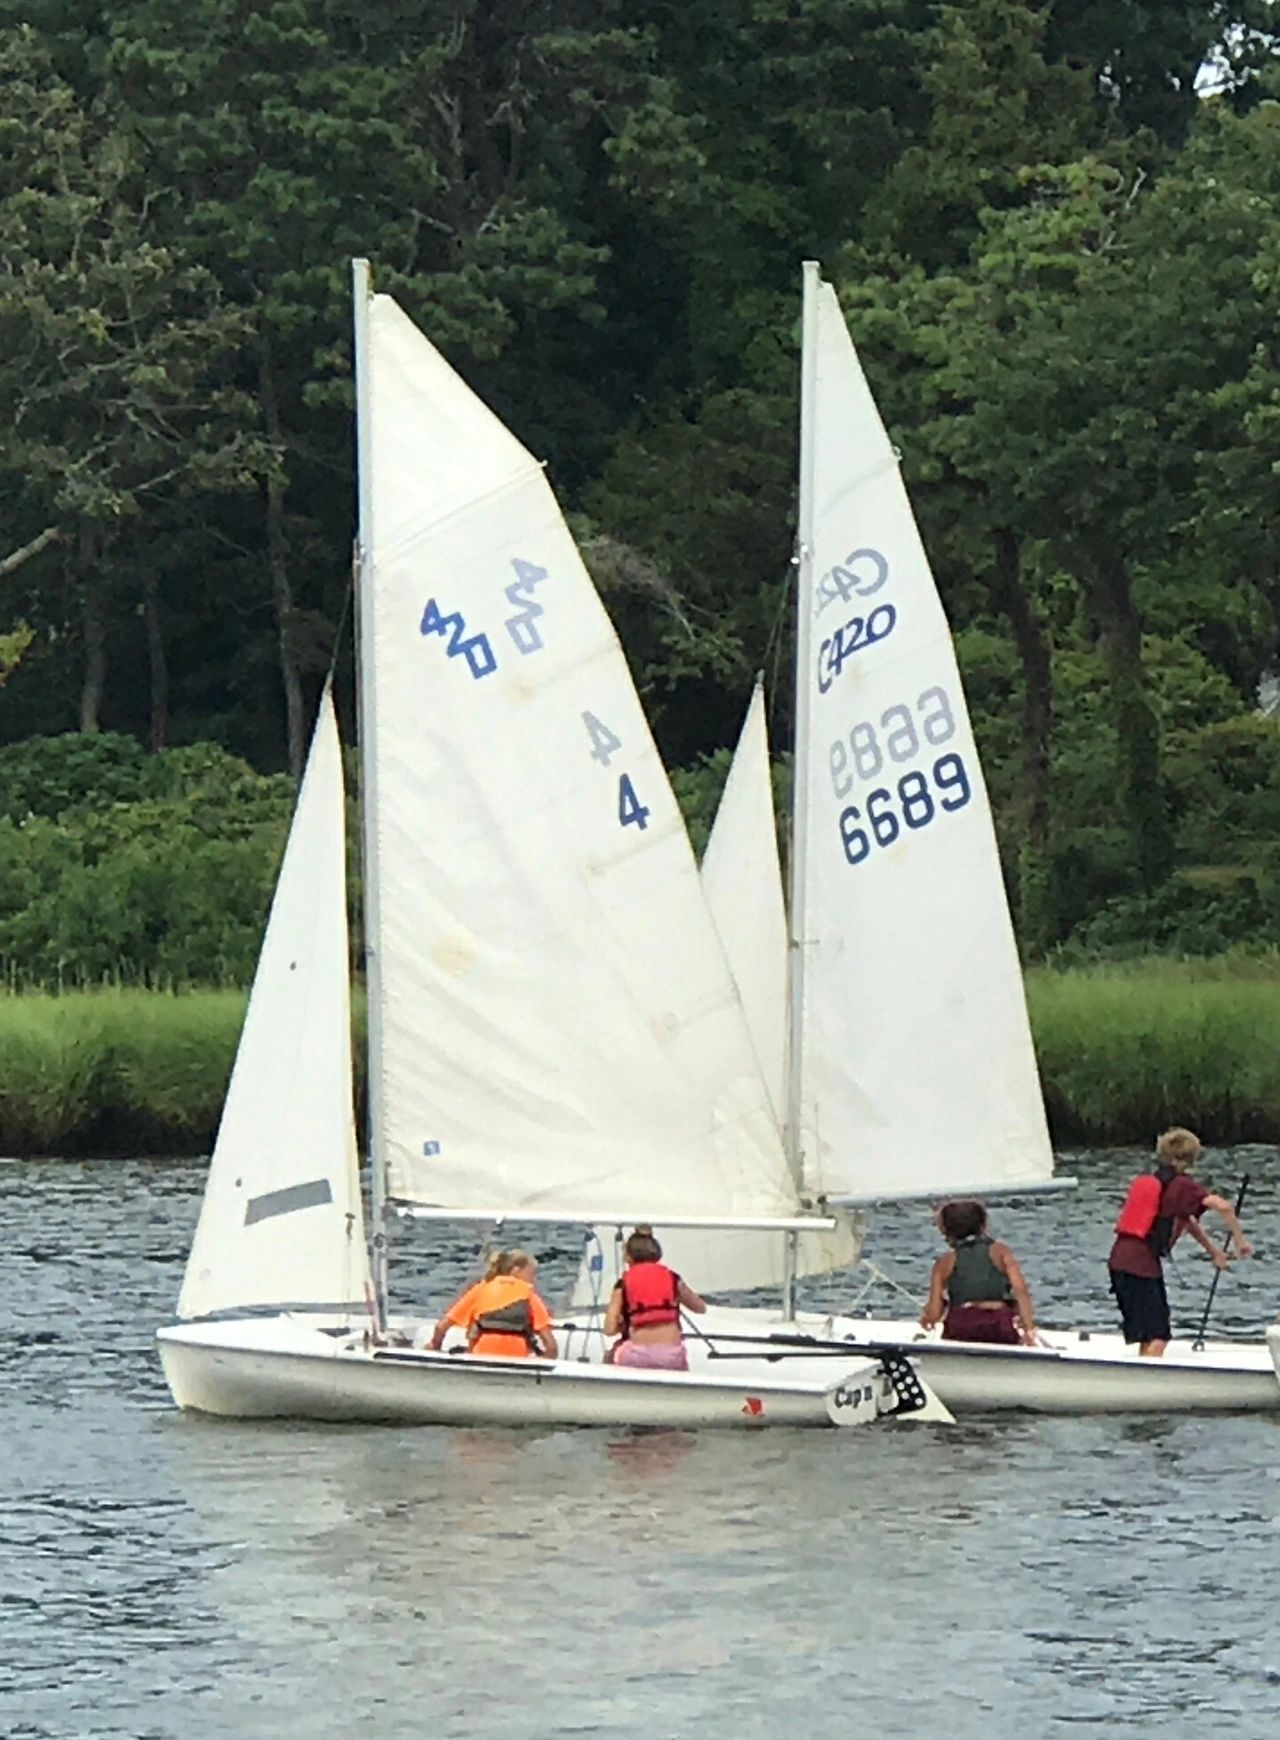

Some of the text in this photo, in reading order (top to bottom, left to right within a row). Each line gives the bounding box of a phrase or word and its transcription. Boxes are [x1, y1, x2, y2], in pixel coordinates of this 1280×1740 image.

[420, 598, 498, 680] 420
[817, 603, 897, 694] C420
[618, 773, 650, 831] 4
[838, 752, 972, 865] 6689
